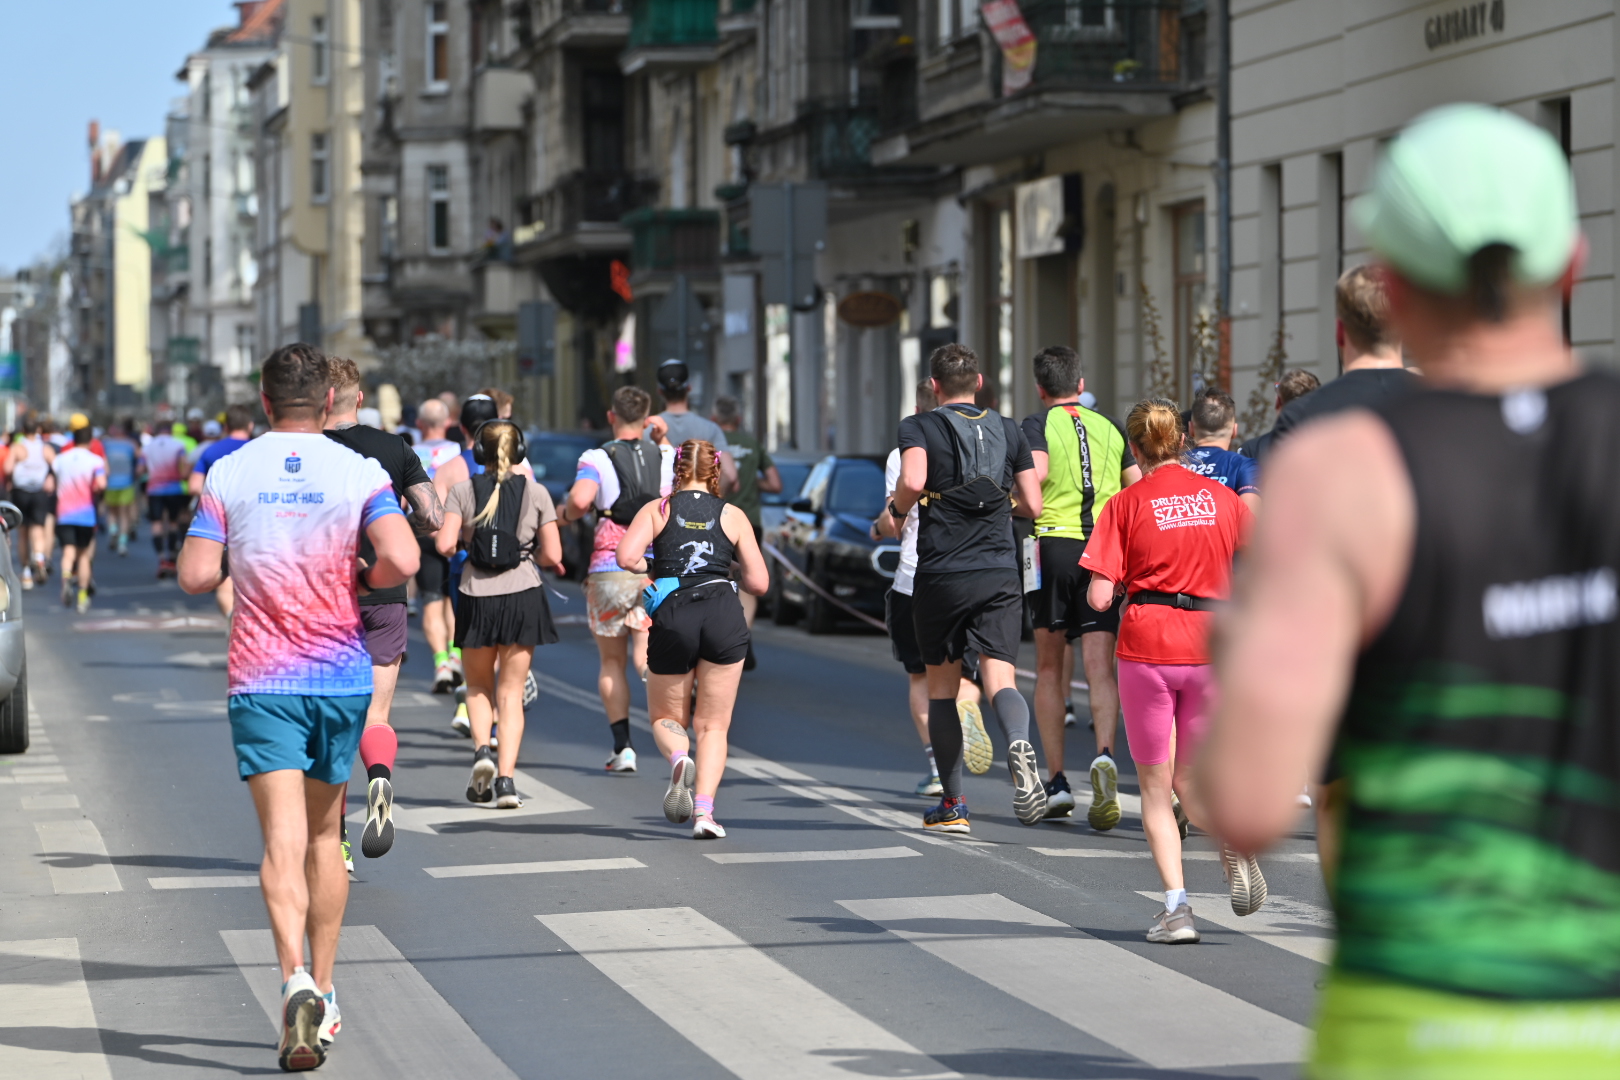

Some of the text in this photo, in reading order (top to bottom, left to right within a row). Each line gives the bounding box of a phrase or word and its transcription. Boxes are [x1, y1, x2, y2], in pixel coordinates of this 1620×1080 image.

[258, 492, 325, 504] FILIP LUX-HAUS
[1150, 494, 1205, 509] DRUŻYNA
[1153, 501, 1217, 524] SZPIKU
[1158, 518, 1216, 532] www.darszpiku.pl
